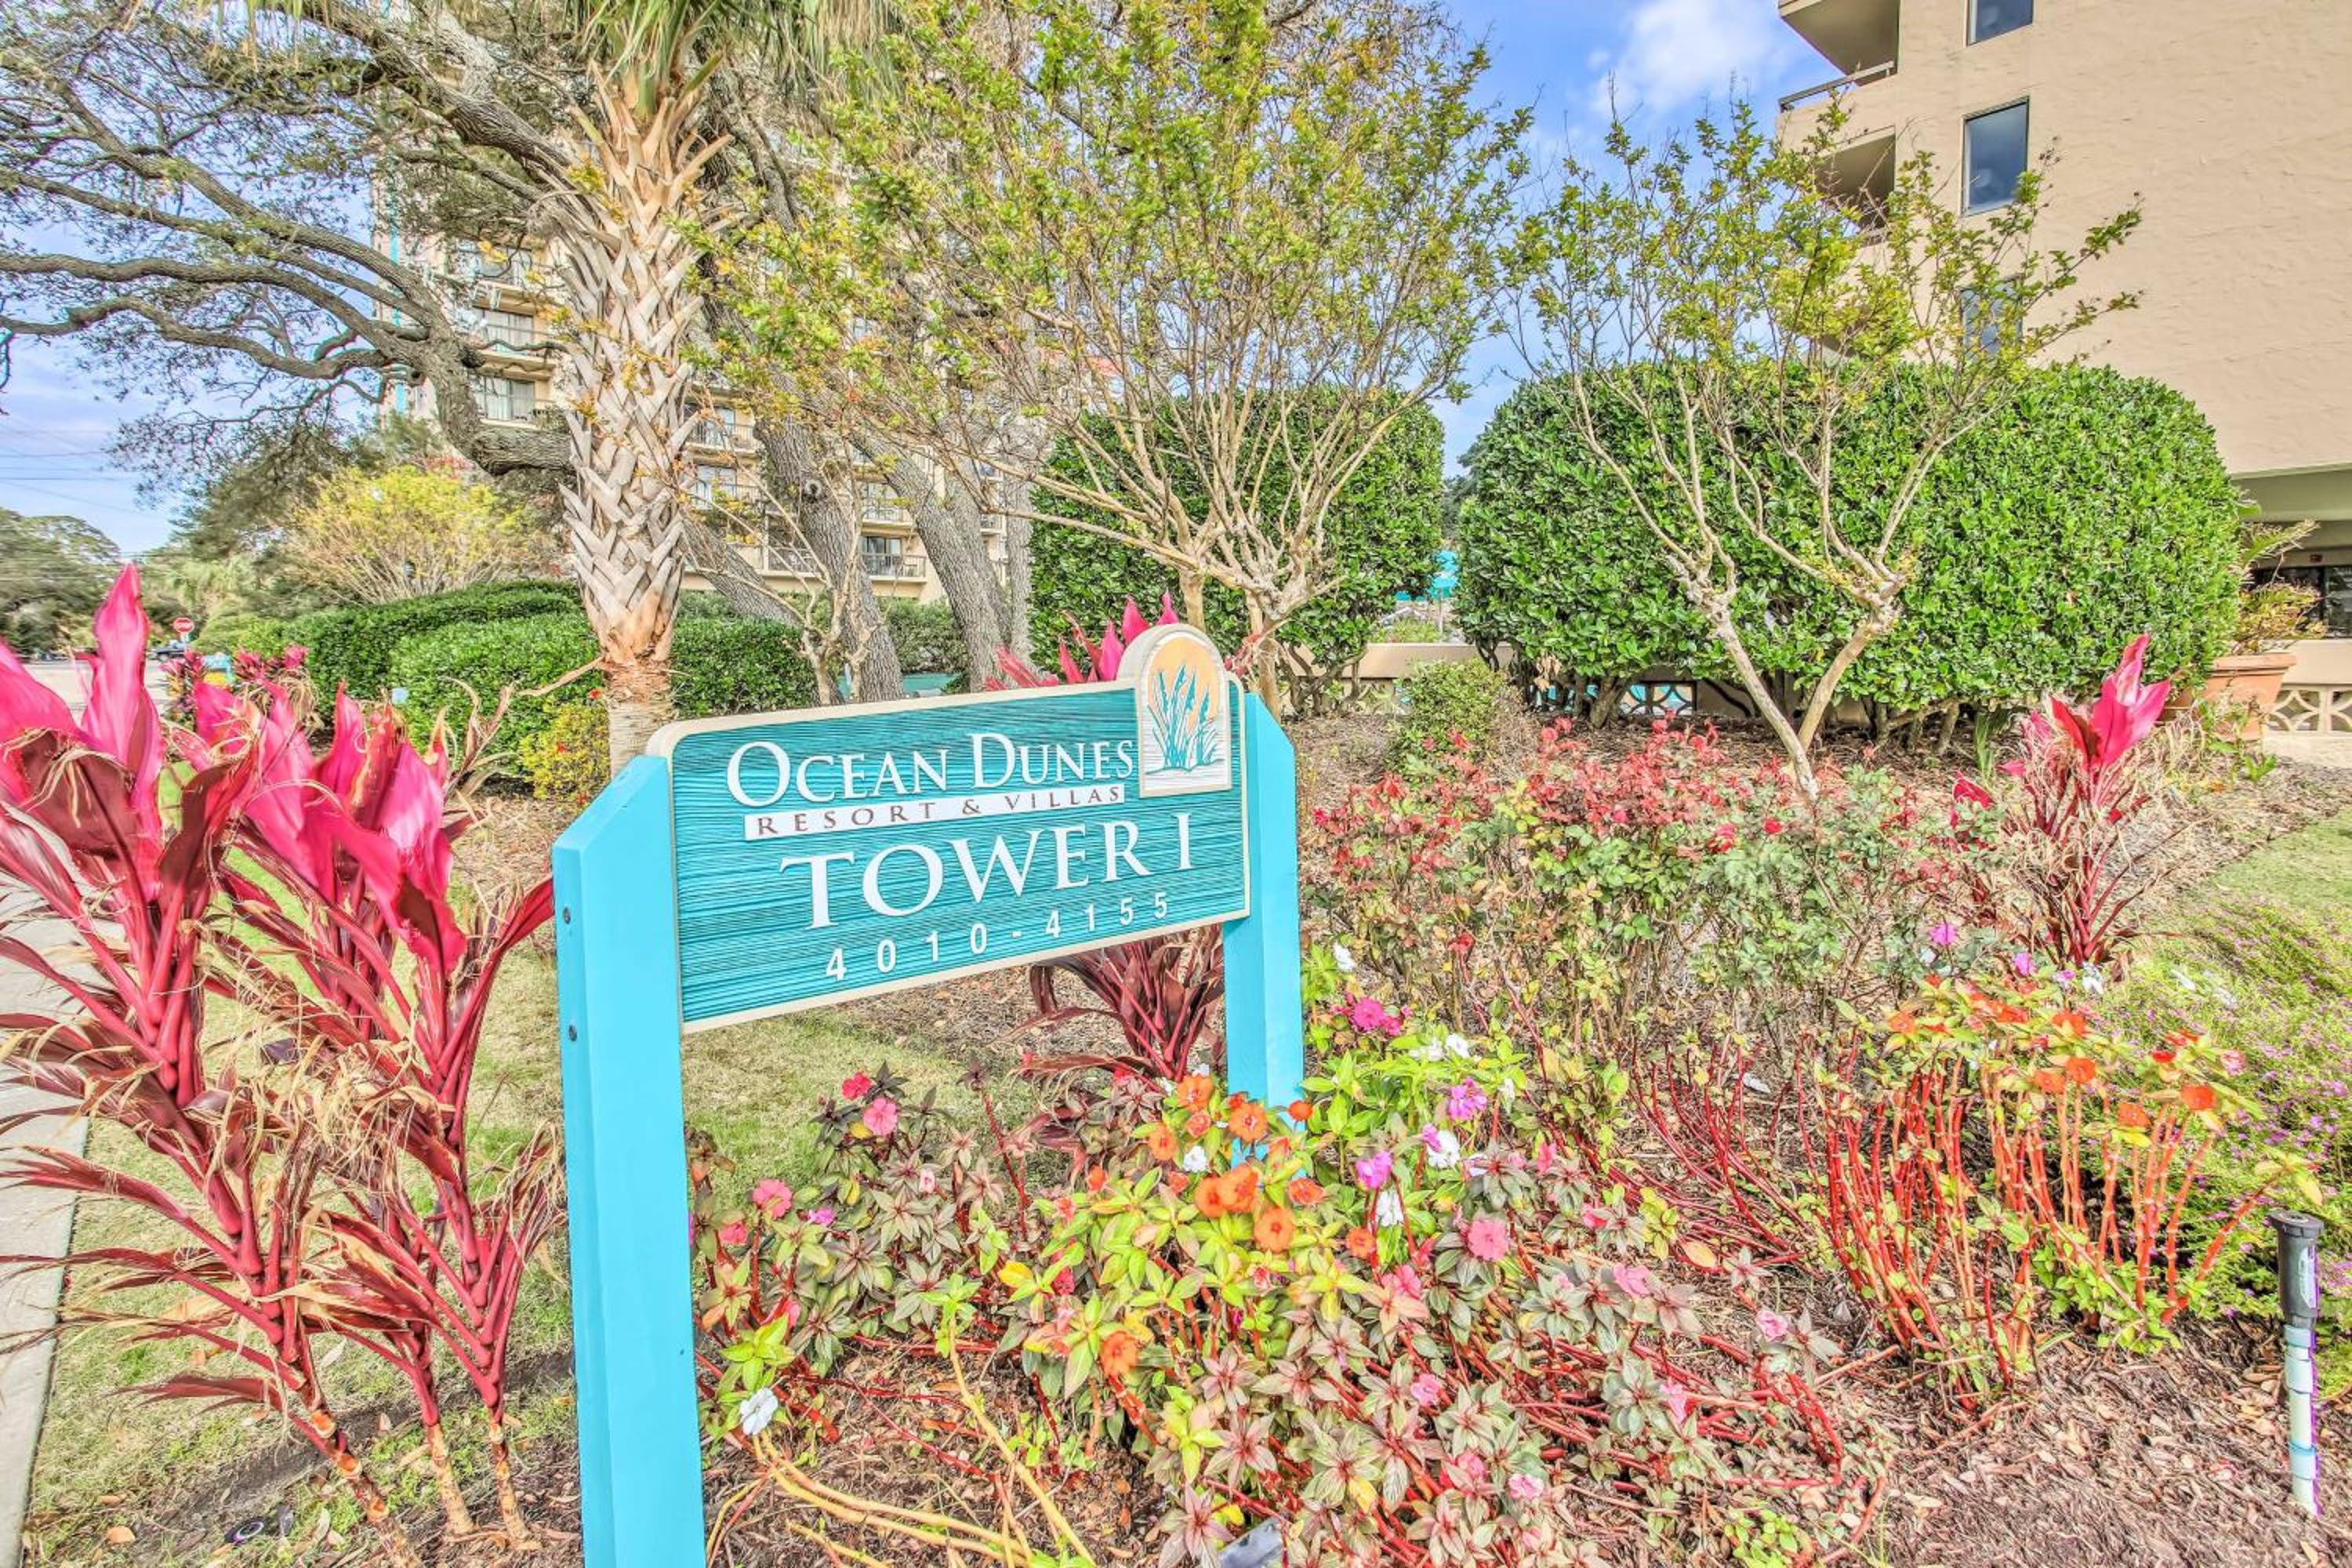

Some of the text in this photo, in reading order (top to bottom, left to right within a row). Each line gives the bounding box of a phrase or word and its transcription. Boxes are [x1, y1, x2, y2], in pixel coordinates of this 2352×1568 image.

[726, 733, 1133, 808] OCEAN DUNES
[757, 786, 1120, 836] RESORT & VILLAS
[780, 814, 1192, 931] TOWER I
